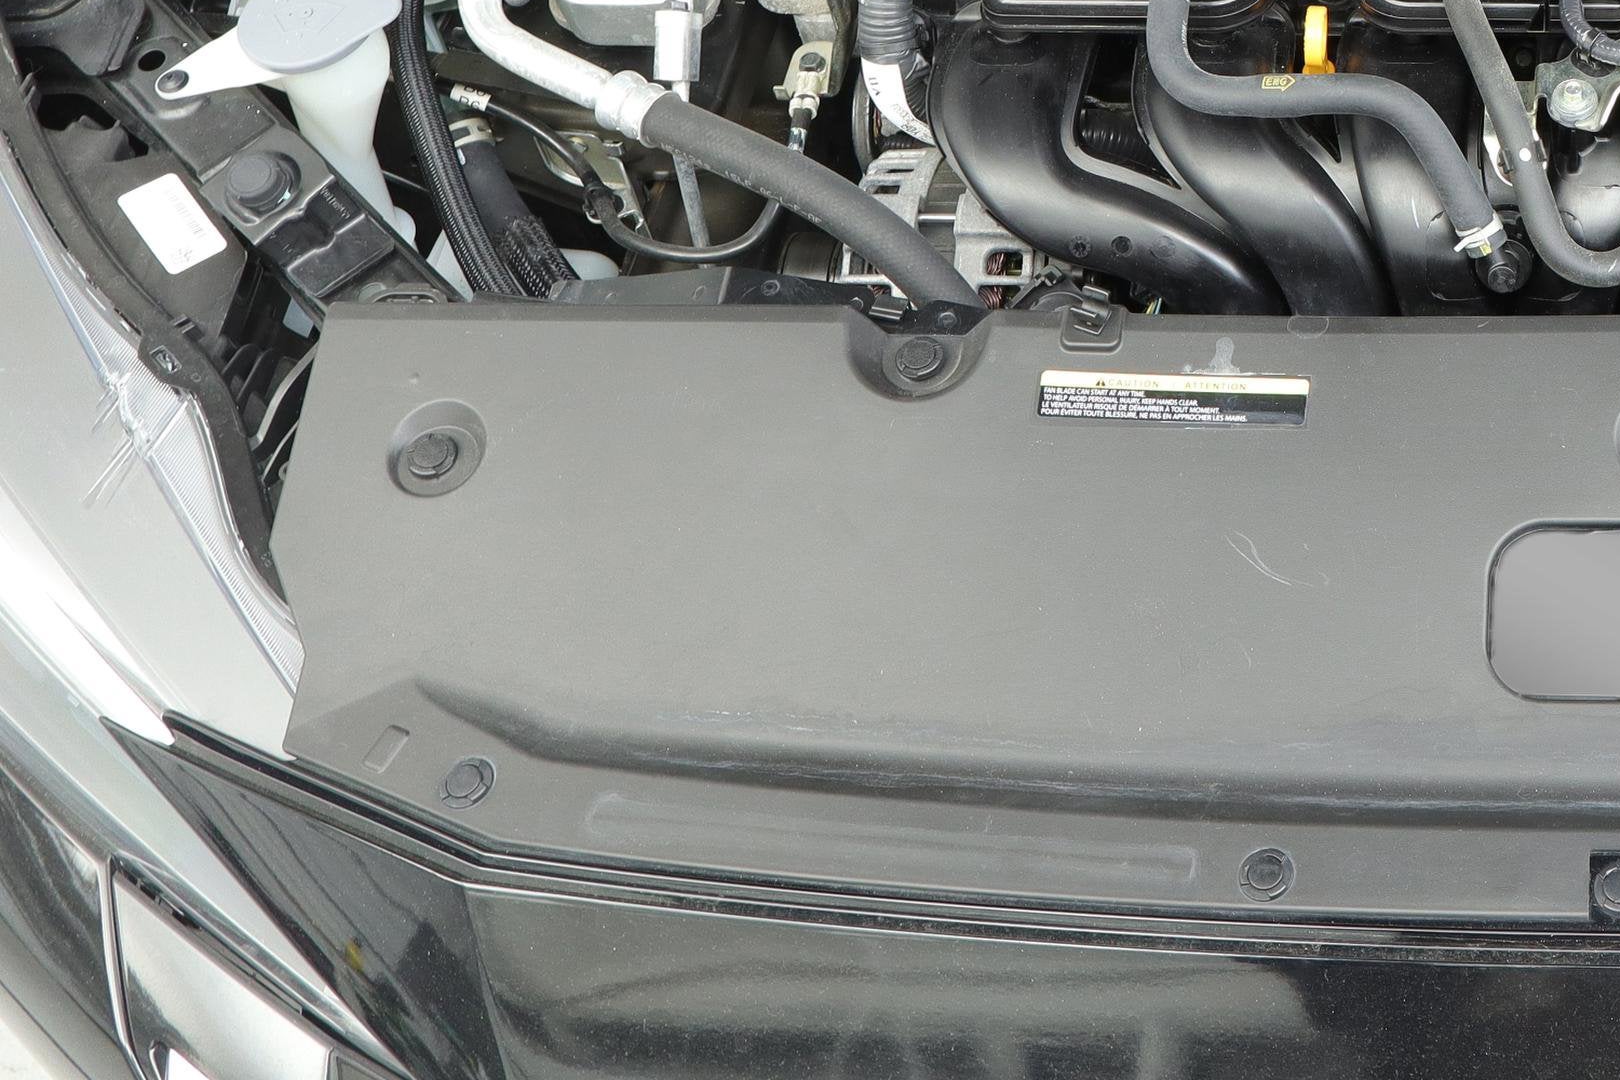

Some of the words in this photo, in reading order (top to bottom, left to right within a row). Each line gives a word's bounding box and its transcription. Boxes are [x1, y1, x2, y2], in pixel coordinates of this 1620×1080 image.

[1108, 379, 1159, 388] CAUTION
[1185, 382, 1247, 391] ATTENTION
[1056, 387, 1075, 395] BLADE
[1090, 388, 1107, 396] START
[1050, 401, 1093, 409] VENTILATEUR
[1093, 403, 1117, 411] RISQUE
[1088, 395, 1118, 403] PERSONAL
[1141, 397, 1155, 405] KEEP
[1156, 398, 1178, 406] HANDS
[1083, 409, 1104, 417] TOUTE
[1138, 411, 1148, 419] NE
[1163, 412, 1171, 420] EN
[1172, 413, 1211, 421] APPROCHER
